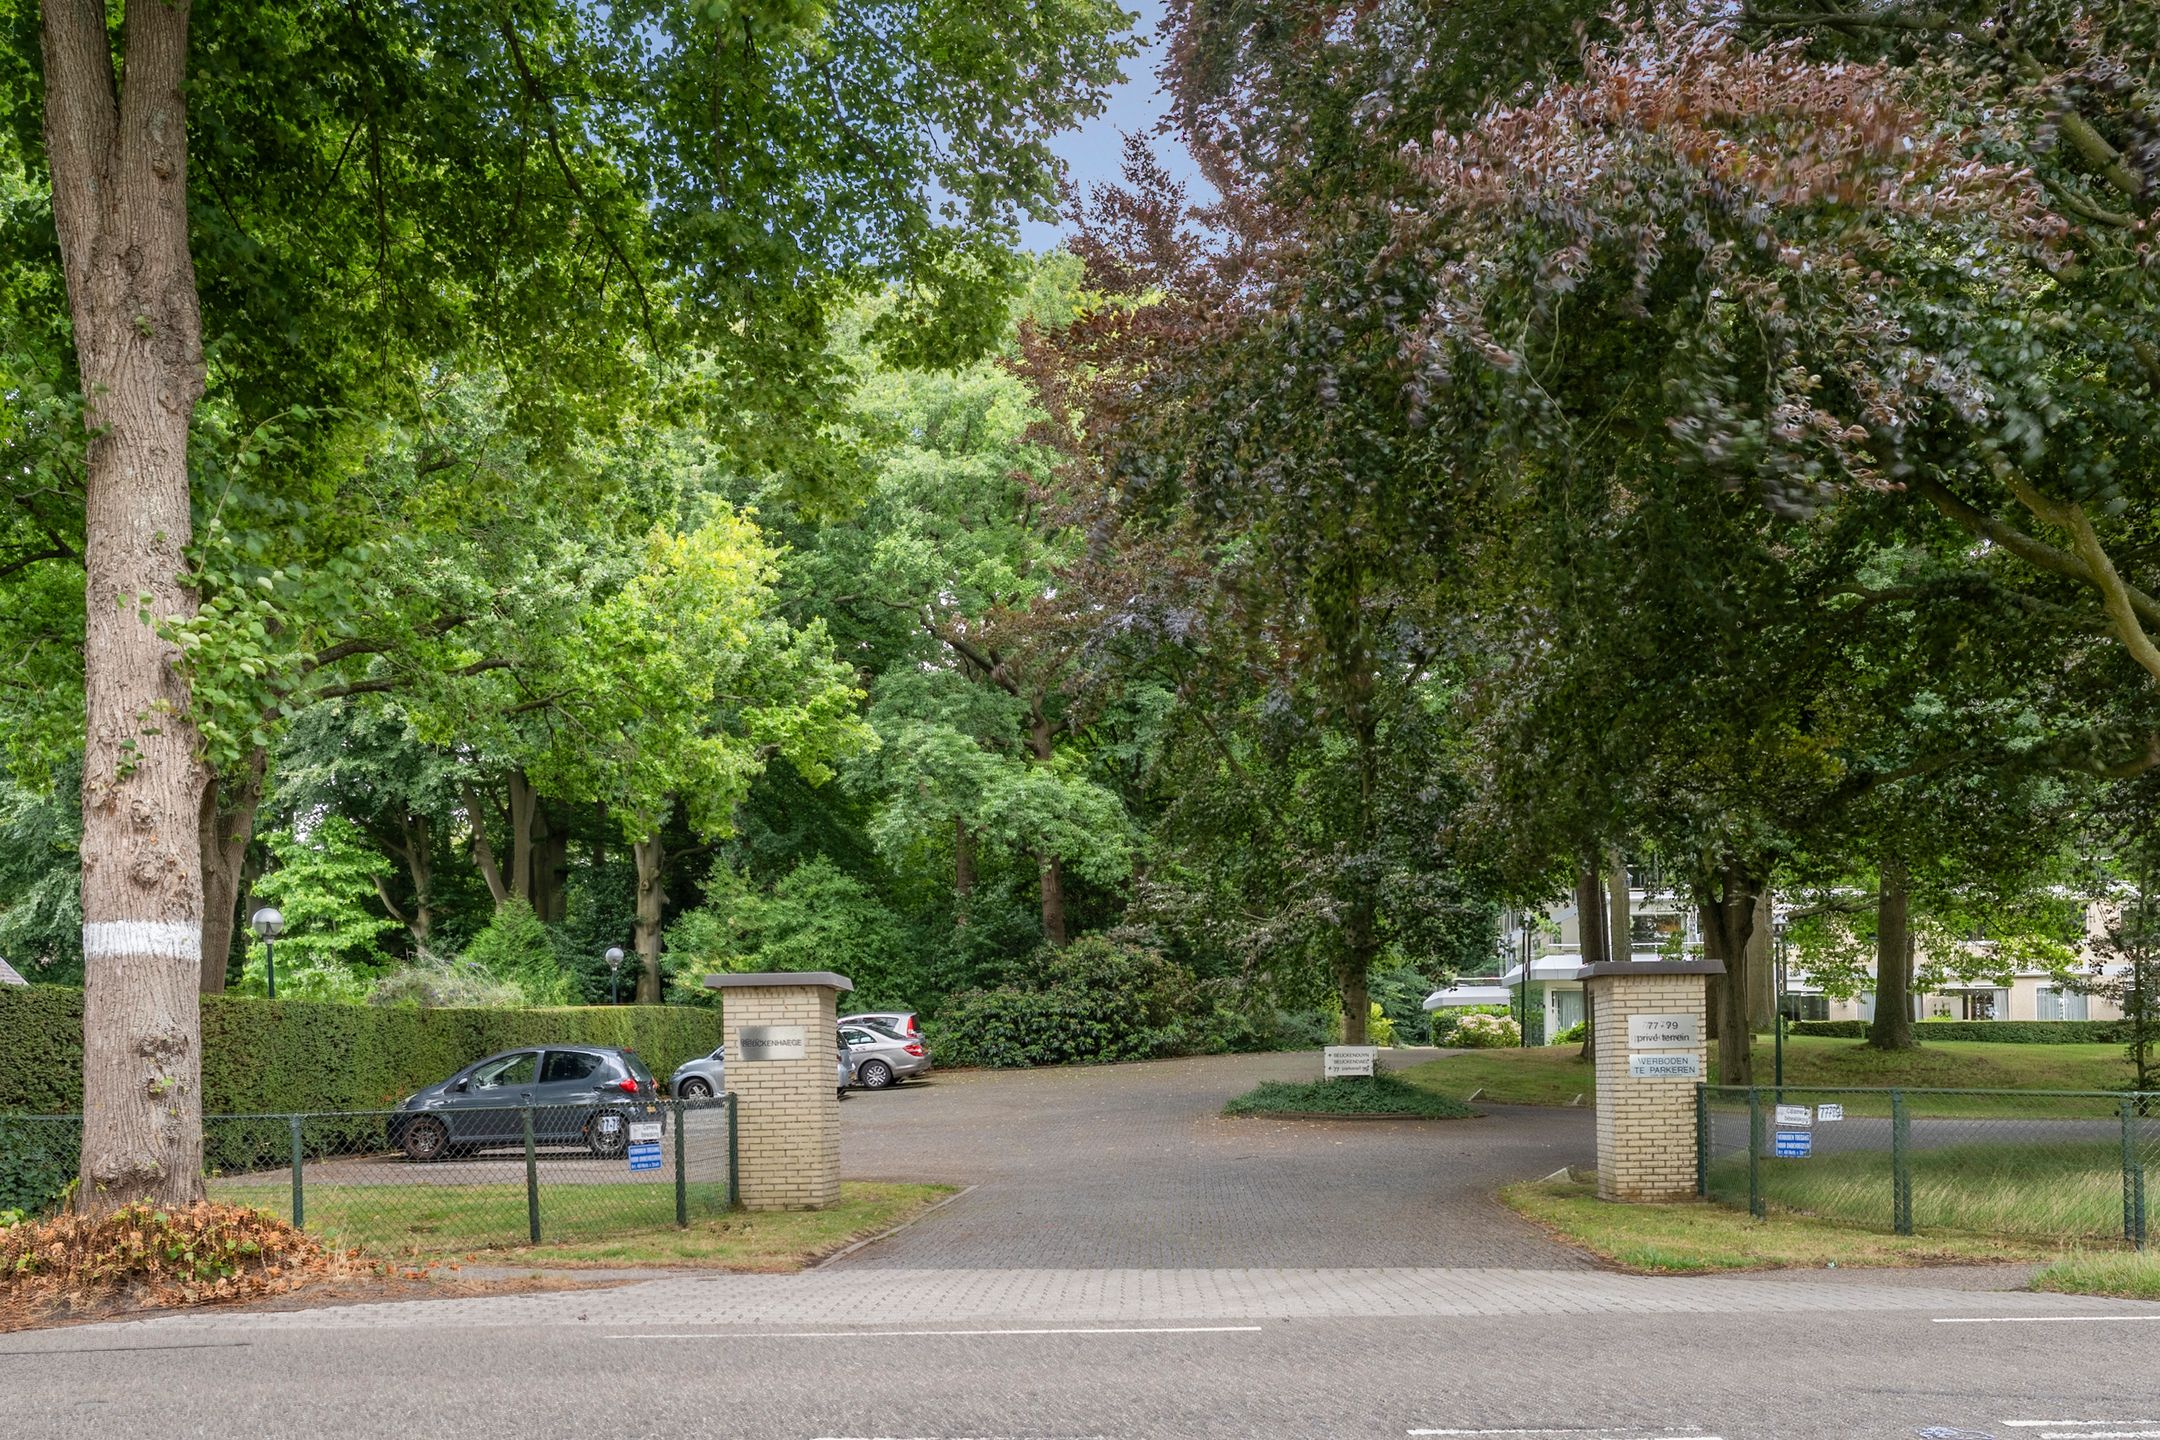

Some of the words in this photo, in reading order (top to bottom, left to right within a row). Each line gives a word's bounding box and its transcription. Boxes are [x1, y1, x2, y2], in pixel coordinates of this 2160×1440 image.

[1661, 1033, 1690, 1042] terrein
[1638, 1057, 1689, 1065] VERBODEN
[1649, 1066, 1696, 1074] PARKEREN
